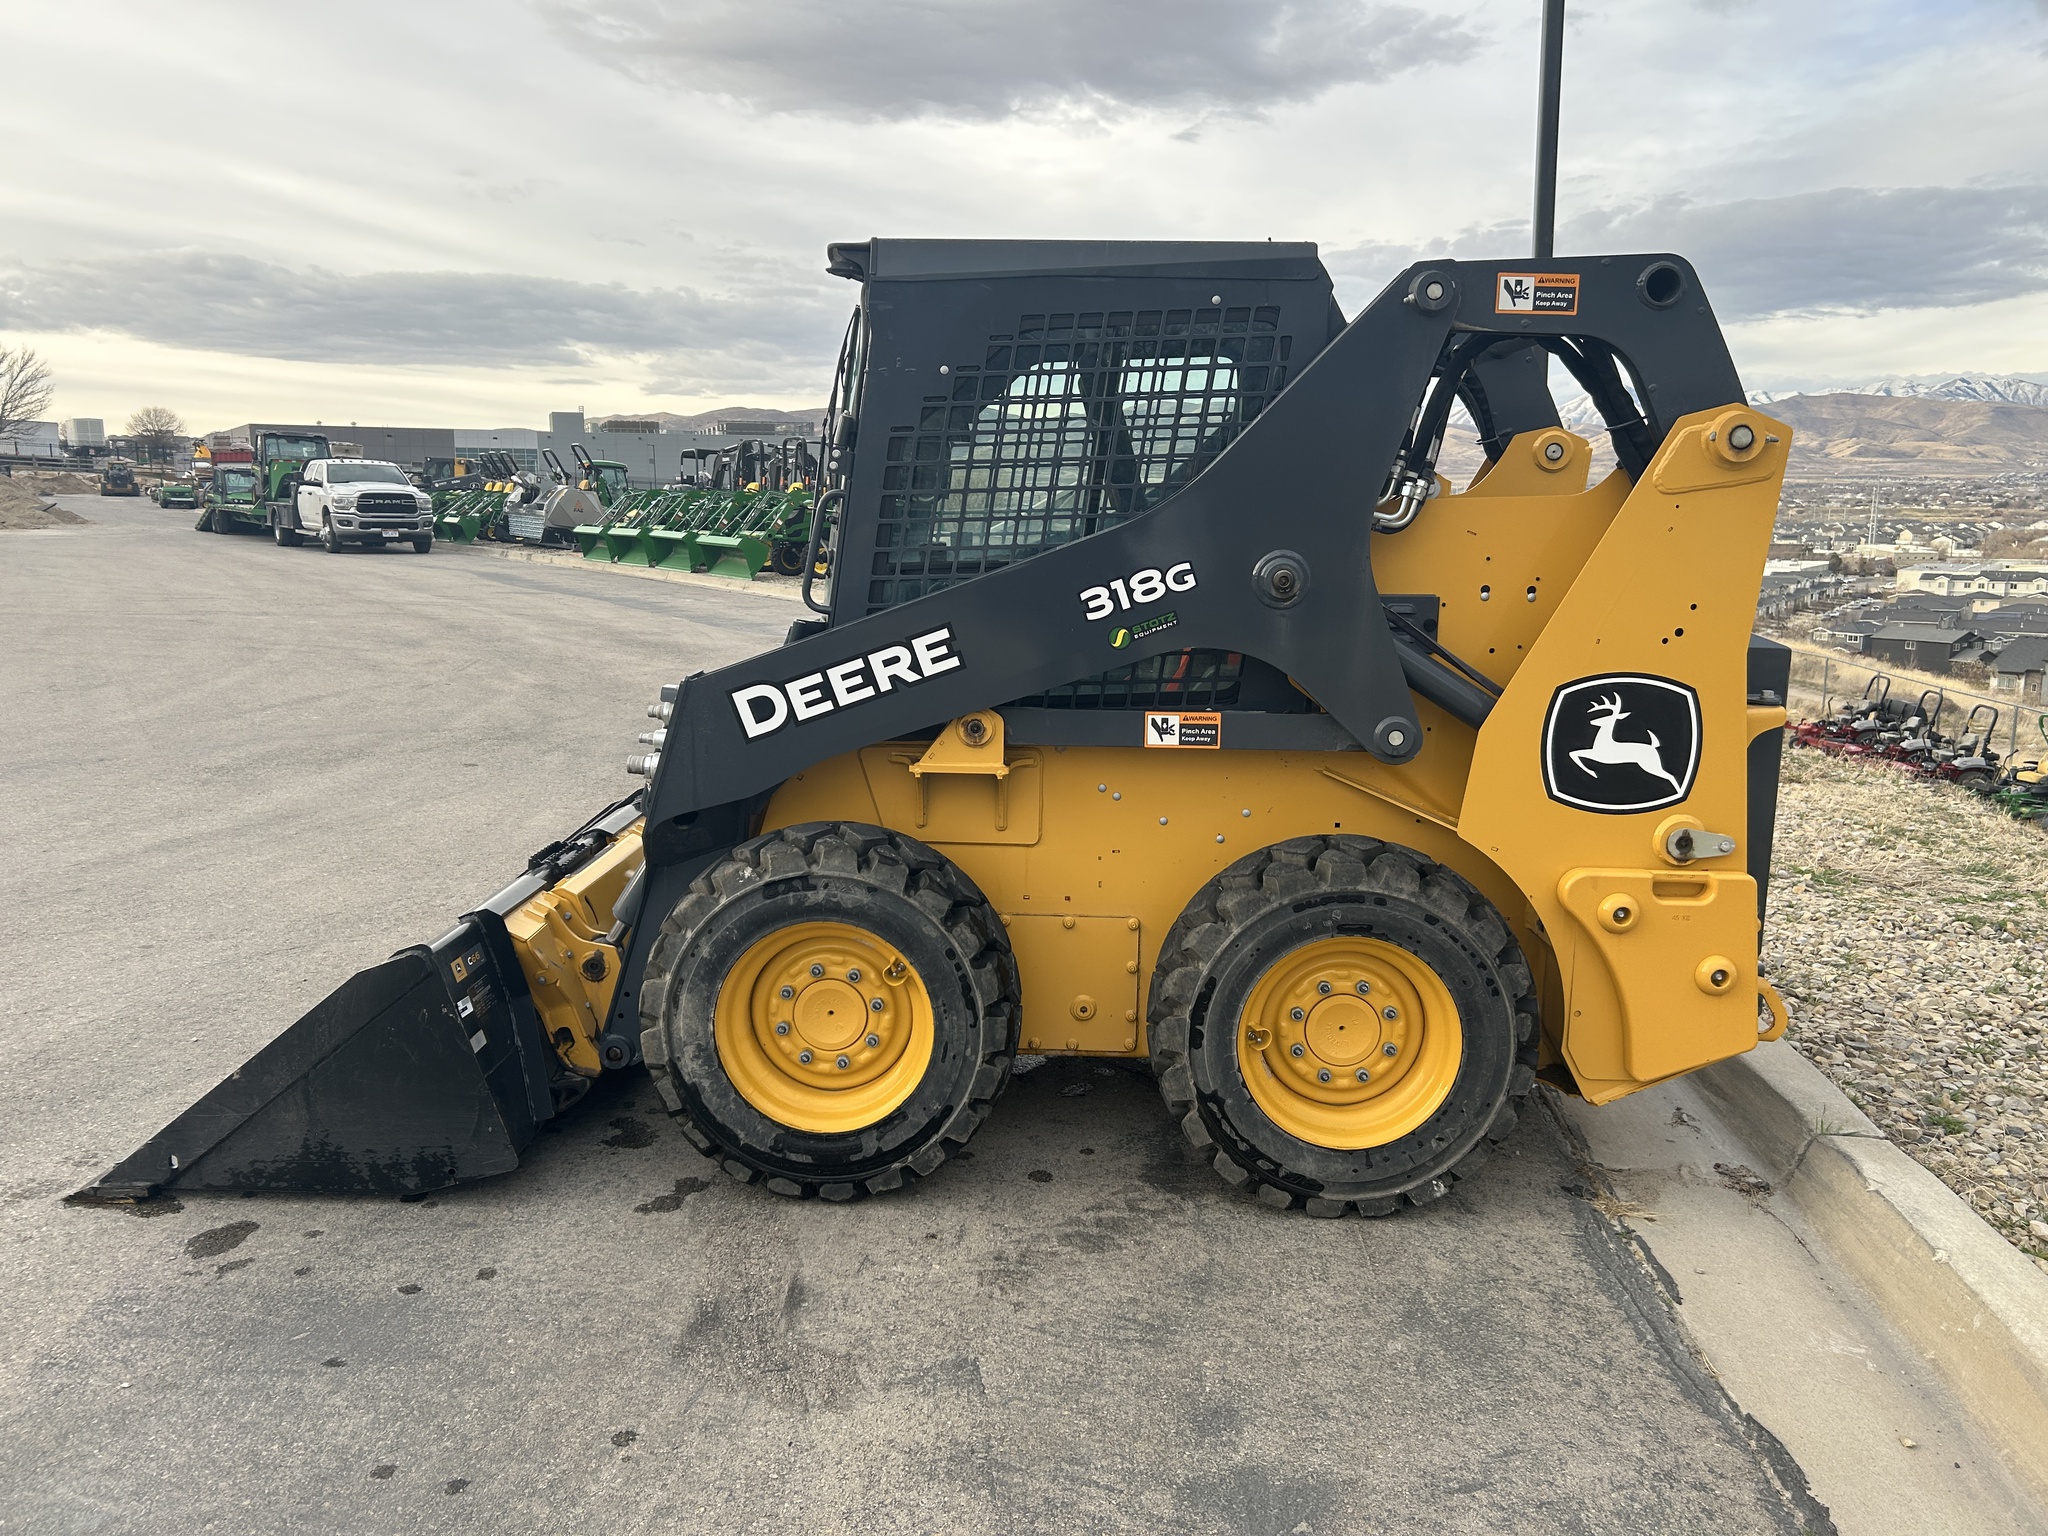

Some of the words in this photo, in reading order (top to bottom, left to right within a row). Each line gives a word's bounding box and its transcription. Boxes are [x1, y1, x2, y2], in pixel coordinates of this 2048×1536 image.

[1544, 276, 1576, 285] WARNING
[1536, 291, 1555, 299] Pinch
[1080, 562, 1196, 620] 318G
[1134, 620, 1178, 639] EQUIPMENT
[731, 627, 961, 739] DEERE
